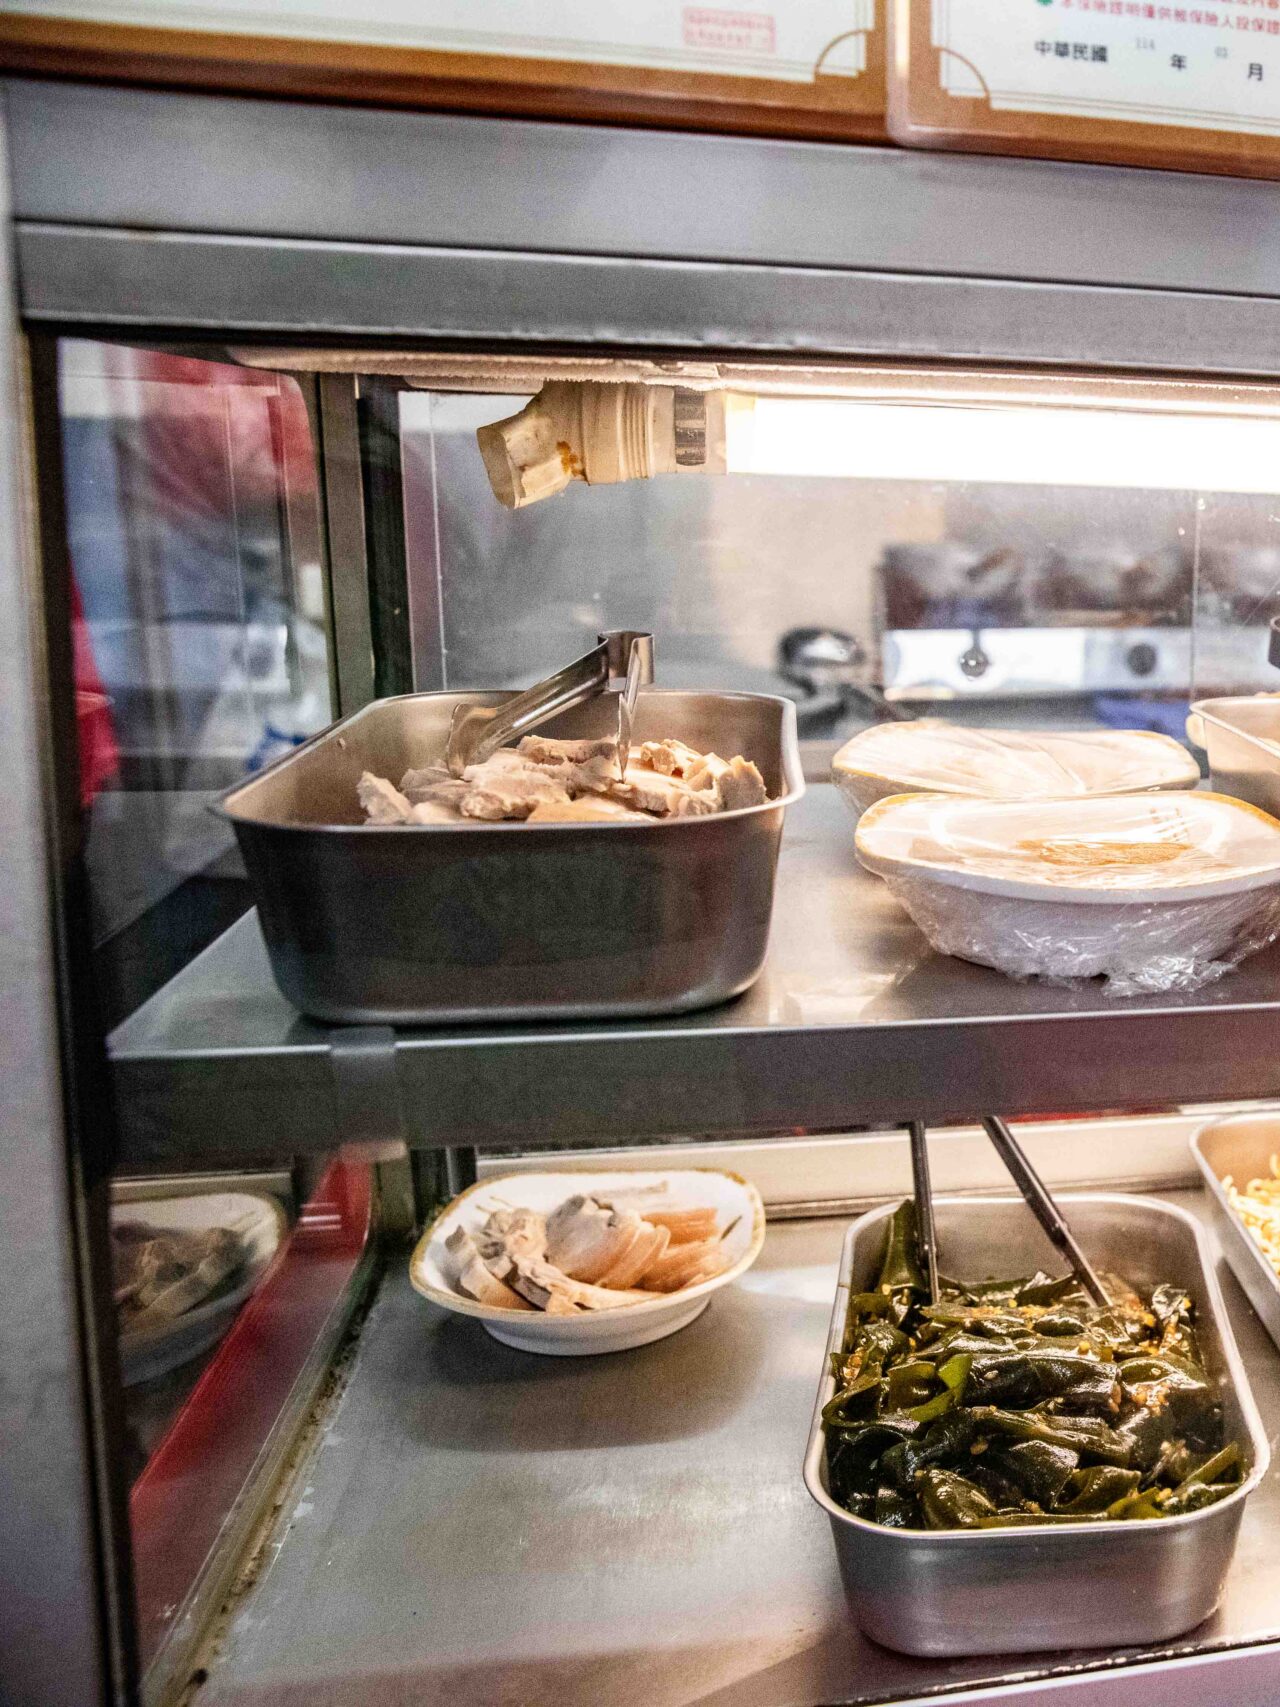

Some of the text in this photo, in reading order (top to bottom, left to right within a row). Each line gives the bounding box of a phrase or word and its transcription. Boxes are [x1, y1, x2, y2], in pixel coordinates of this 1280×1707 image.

[1034, 40, 1107, 63] 中華民國
[1170, 54, 1187, 71] 年
[1248, 62, 1263, 81] 月
